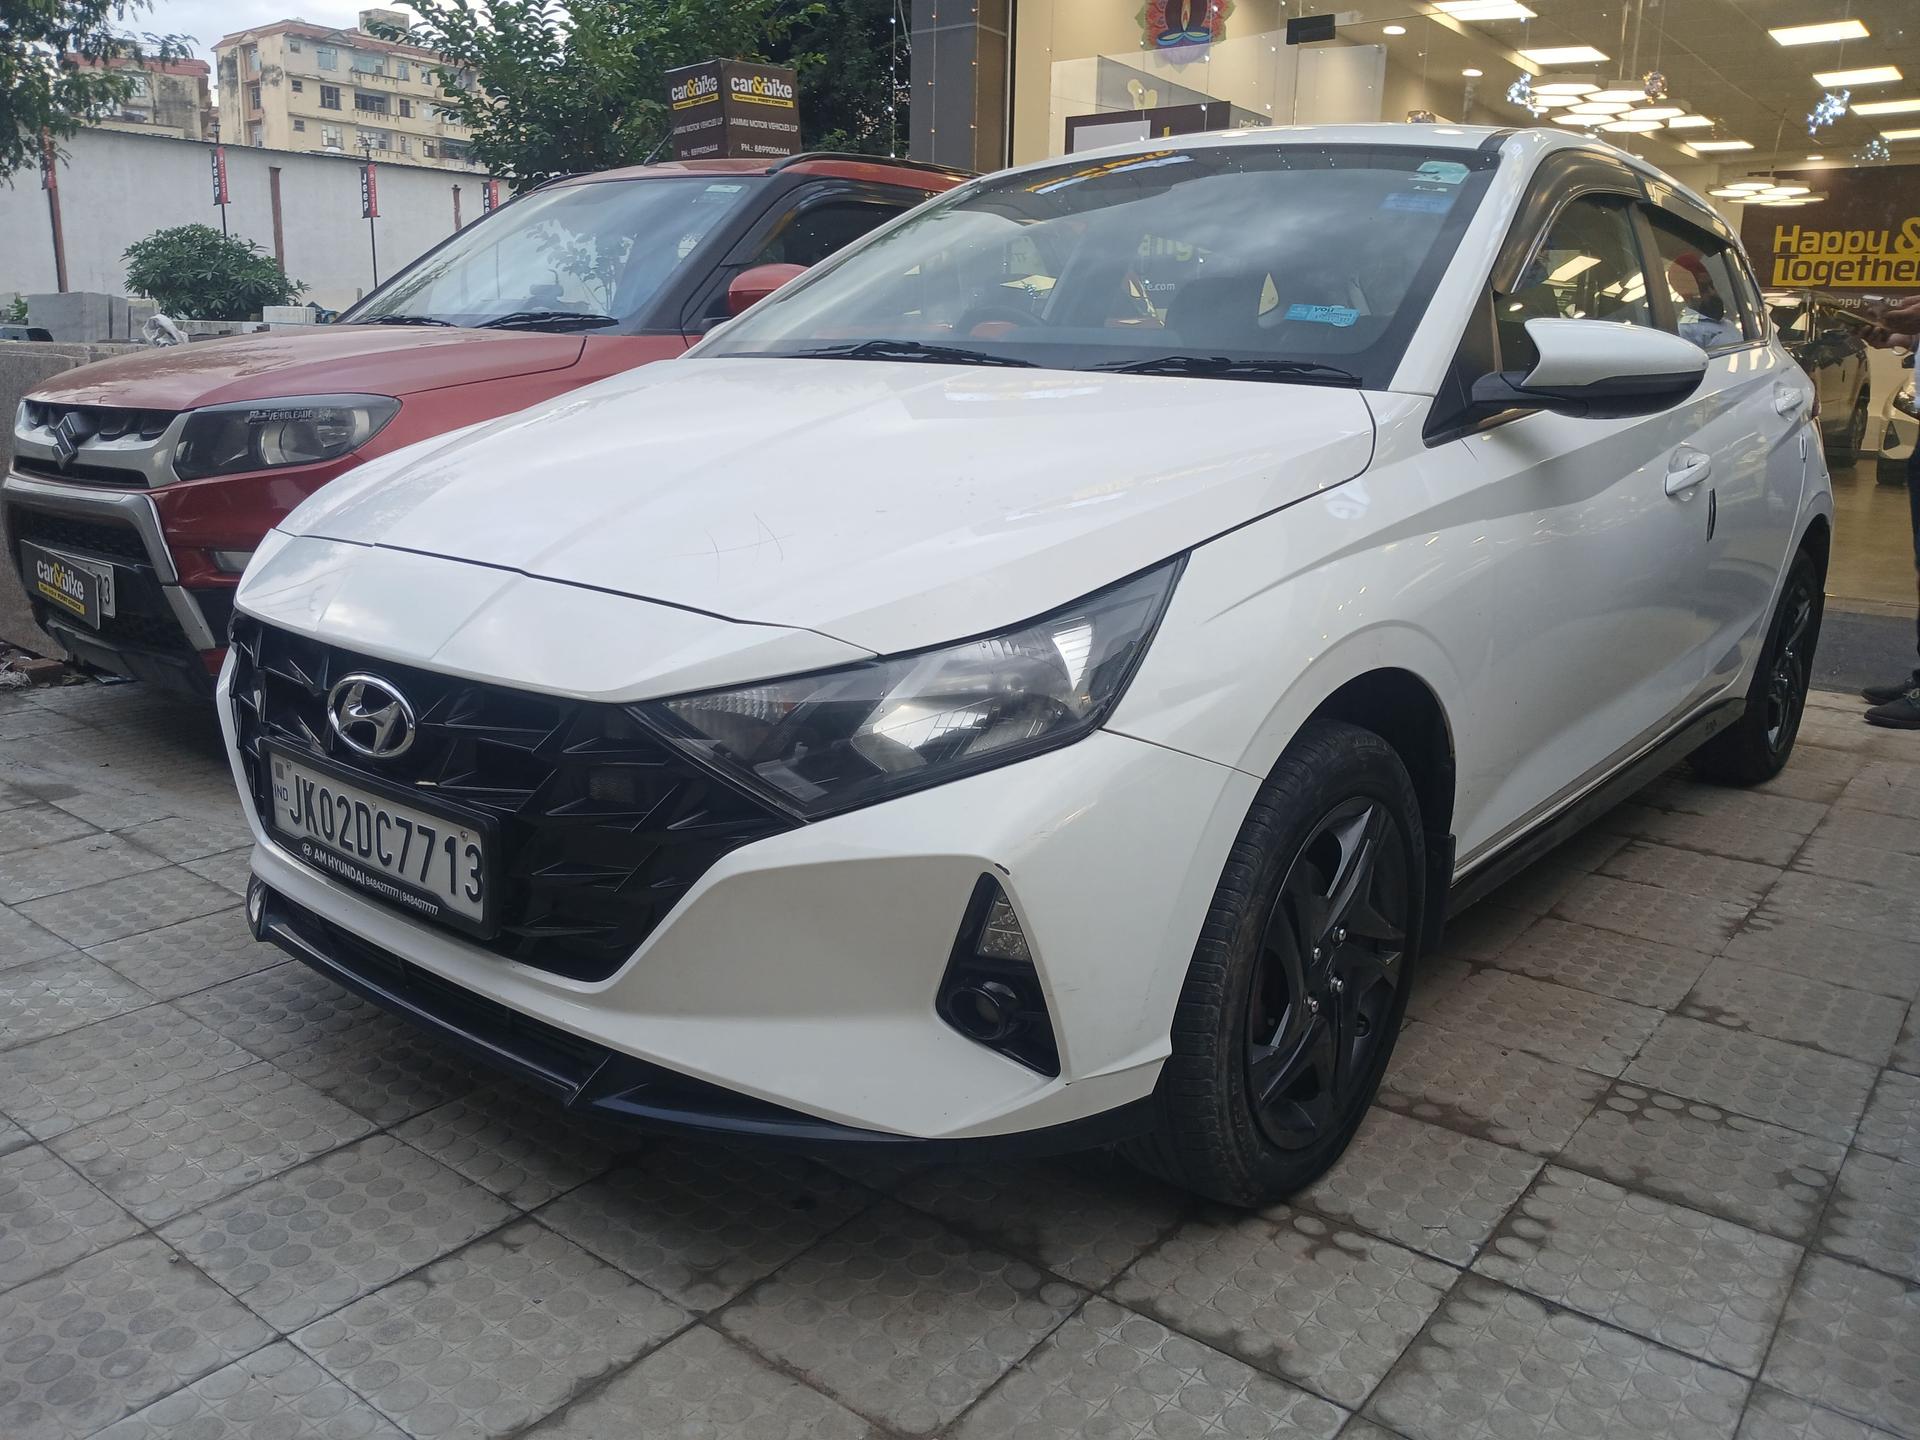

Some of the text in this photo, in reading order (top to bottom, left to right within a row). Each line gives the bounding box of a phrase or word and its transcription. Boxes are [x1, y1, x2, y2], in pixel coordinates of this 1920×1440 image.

[671, 75, 718, 101] car&bike
[731, 75, 793, 98] car&bike
[750, 119, 768, 129] MOTOR
[212, 156, 220, 197] Jeep
[1773, 225, 1889, 255] Happy
[37, 560, 84, 601] car&bike
[289, 773, 484, 904] JK02DC7713
[314, 848, 327, 864] AM
[327, 855, 365, 886] HYUNDAI
